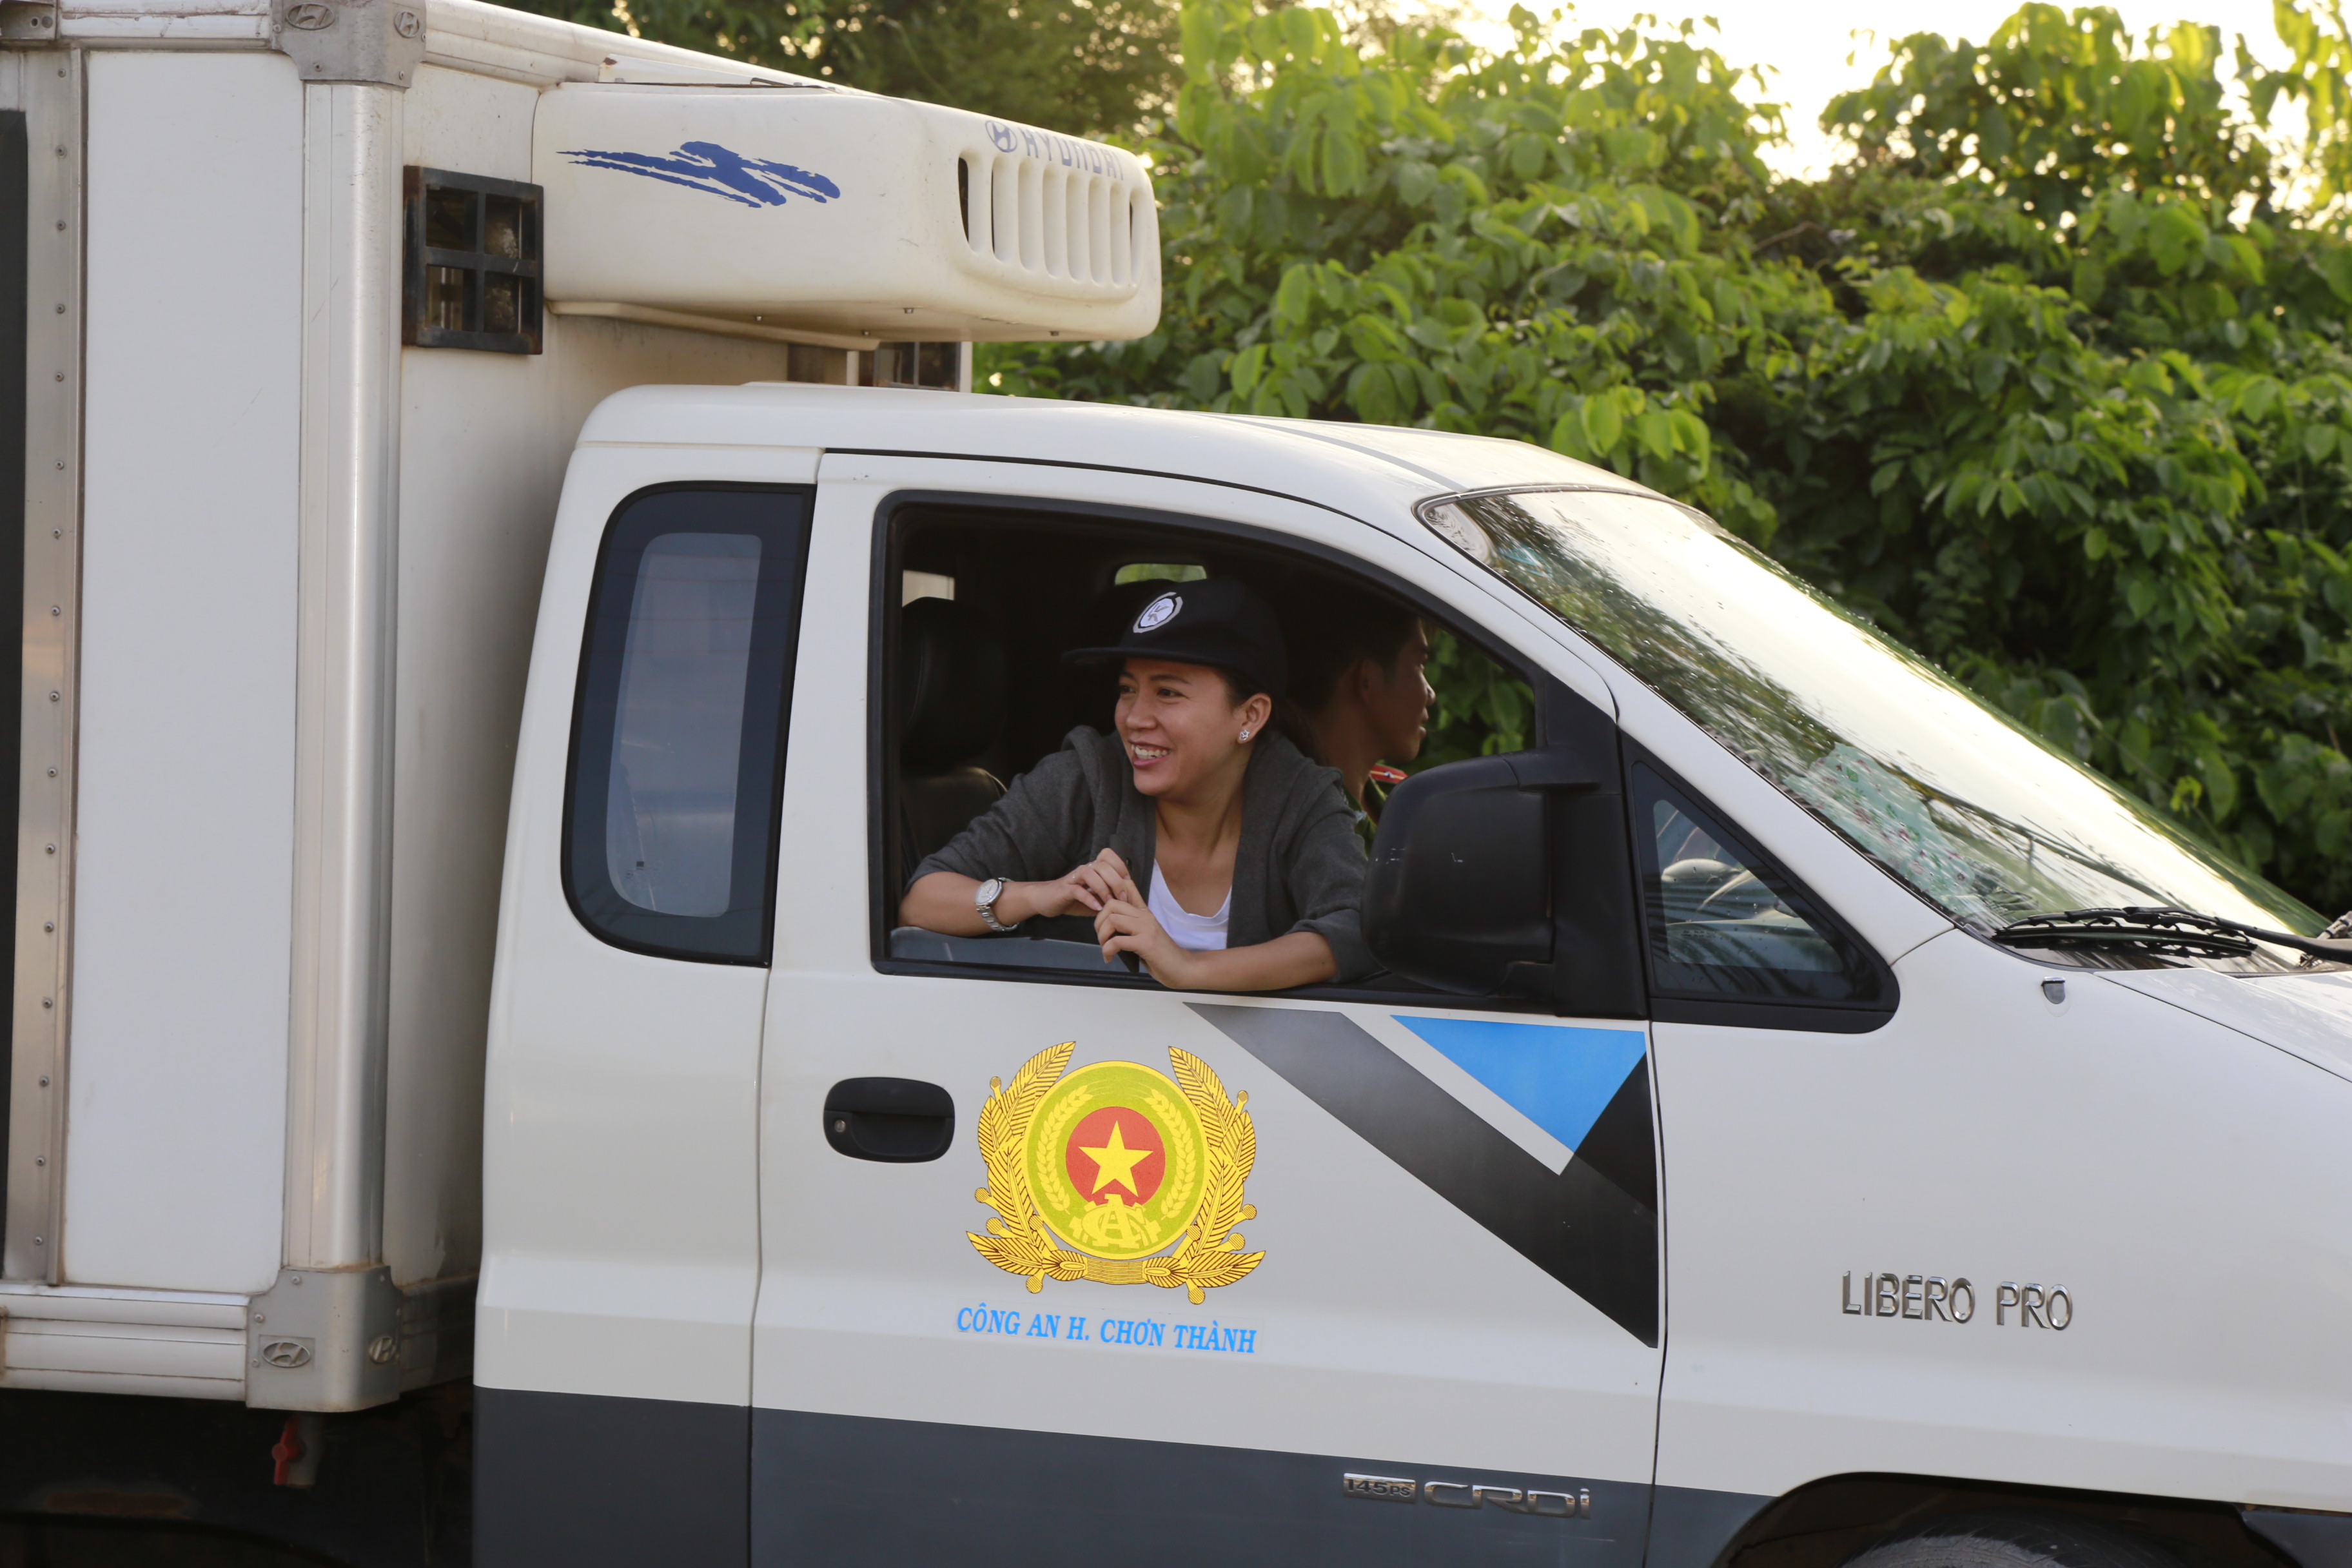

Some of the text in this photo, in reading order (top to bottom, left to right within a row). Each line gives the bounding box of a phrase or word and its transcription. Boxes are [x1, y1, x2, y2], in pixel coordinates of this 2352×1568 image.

[1019, 126, 1123, 181] HYUNDAI
[957, 1302, 1257, 1353] CÔNG AN H. CHƠN THÀNH
[1842, 1270, 2073, 1331] LIBERO PRO
